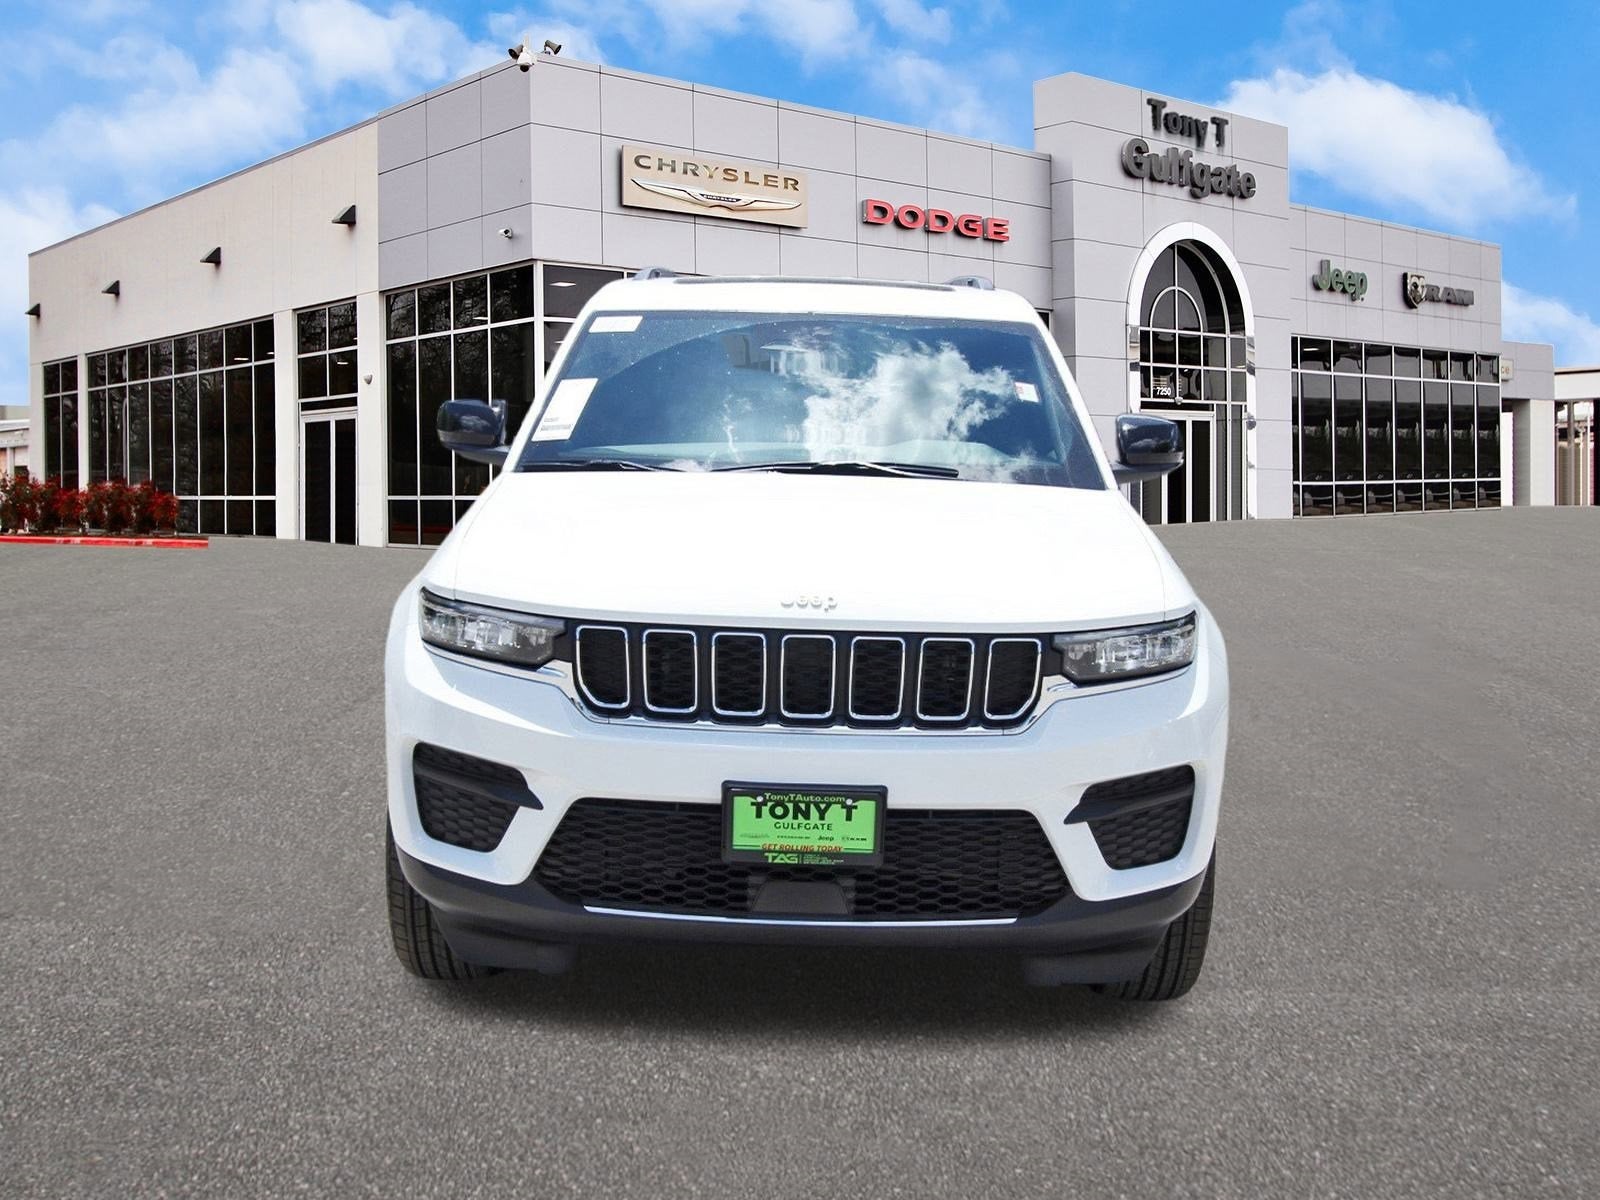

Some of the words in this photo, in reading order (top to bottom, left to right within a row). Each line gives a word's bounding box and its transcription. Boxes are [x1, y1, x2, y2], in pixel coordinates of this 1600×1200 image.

[1147, 98, 1208, 148] Tony
[1210, 116, 1229, 147] T
[633, 154, 800, 192] CHRYSLER
[1121, 138, 1256, 199] Gulfgate
[863, 198, 1010, 242] DODGE
[1312, 259, 1368, 301] Jeep
[1425, 284, 1474, 306] RAM
[750, 800, 832, 821] TONY
[841, 801, 858, 822] T
[774, 821, 833, 831] GULFGATE
[778, 844, 815, 852] ROLLING
